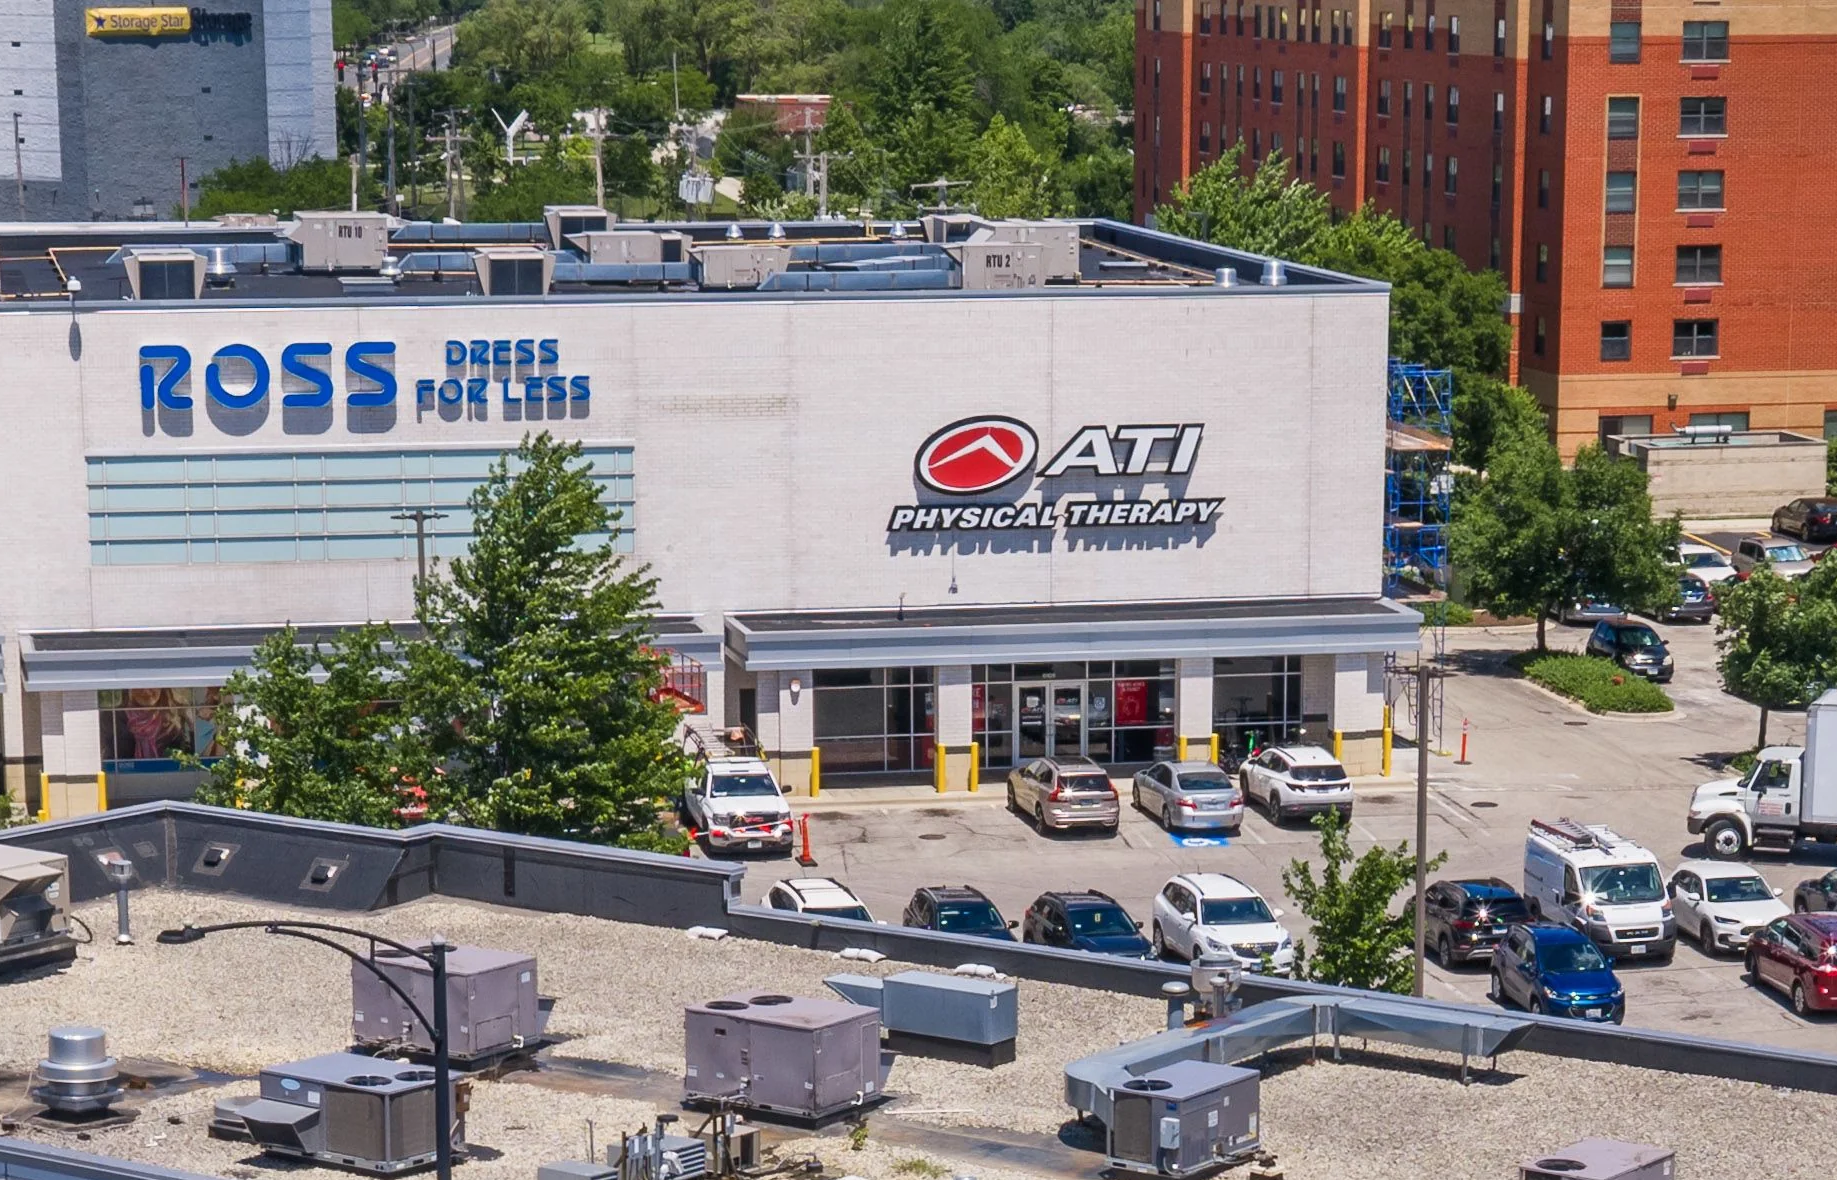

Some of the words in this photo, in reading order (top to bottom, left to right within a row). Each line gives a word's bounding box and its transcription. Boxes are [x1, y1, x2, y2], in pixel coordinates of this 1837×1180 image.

[110, 15, 158, 31] Storage
[161, 15, 185, 28] Star
[337, 225, 352, 239] RTU
[354, 225, 363, 239] 10
[986, 254, 1003, 268] RTU
[1005, 254, 1011, 267] 2
[445, 338, 559, 366] DRESS
[139, 341, 397, 410] ROSS
[416, 378, 489, 405] FOR
[502, 375, 591, 401] LESS
[1037, 423, 1205, 478] ATI
[889, 505, 1057, 531] PHYSICAL
[1066, 498, 1224, 527] THERAPY
